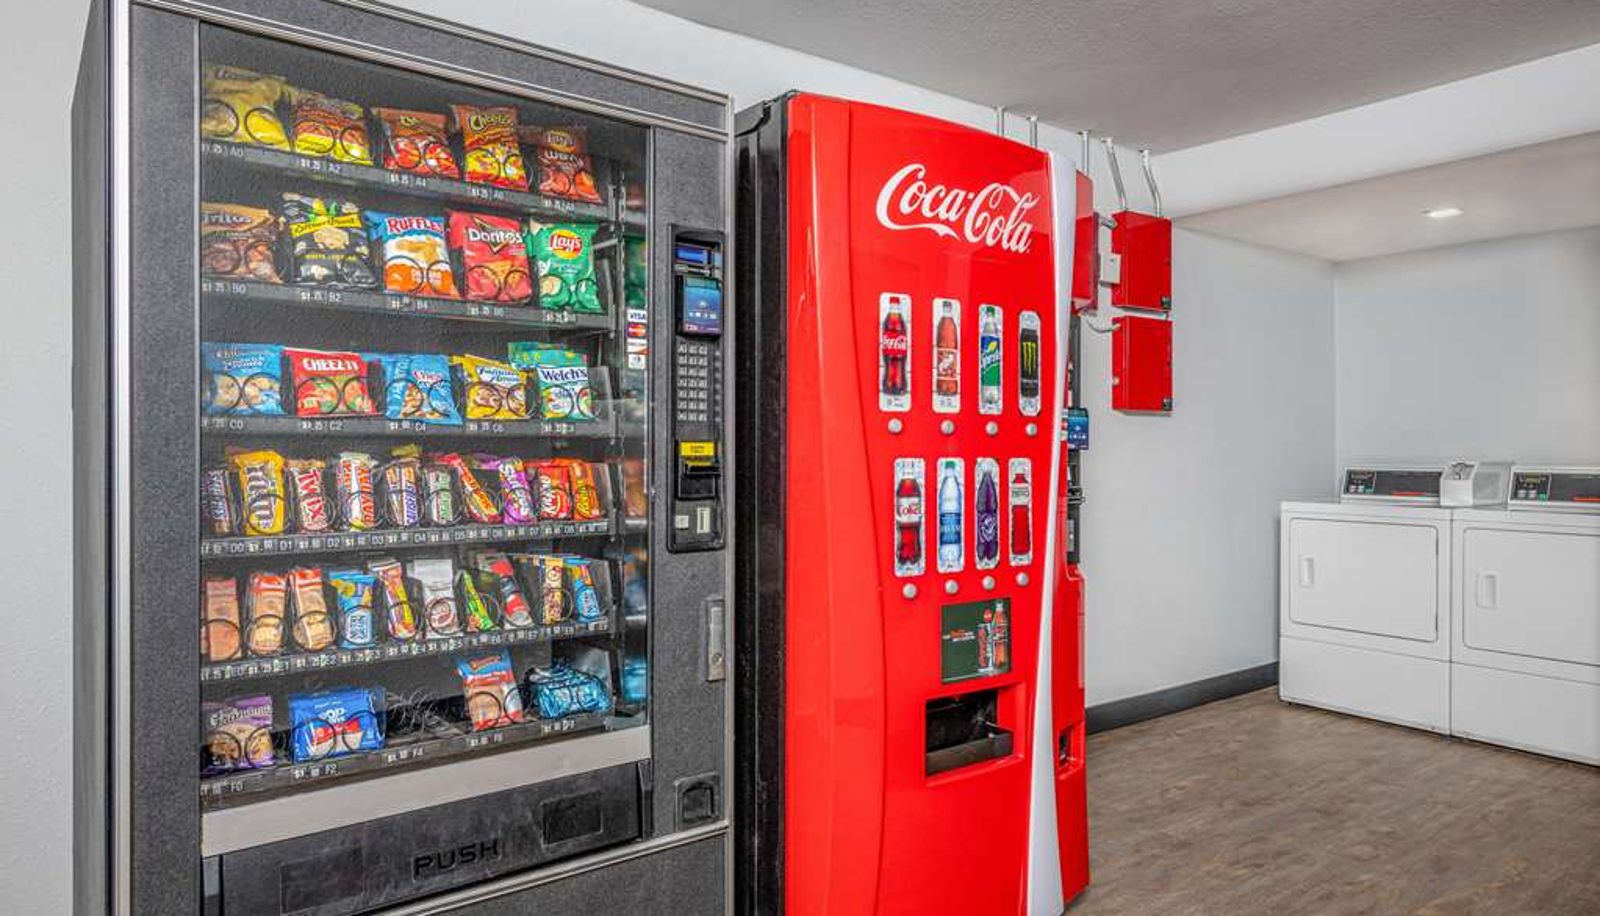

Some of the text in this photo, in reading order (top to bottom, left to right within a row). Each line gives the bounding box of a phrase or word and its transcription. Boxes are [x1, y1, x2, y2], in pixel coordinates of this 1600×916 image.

[876, 163, 1040, 254] Coca-Cola
[467, 227, 523, 244] Doritos
[541, 367, 588, 382] Welch's
[413, 841, 500, 877] PUSH
